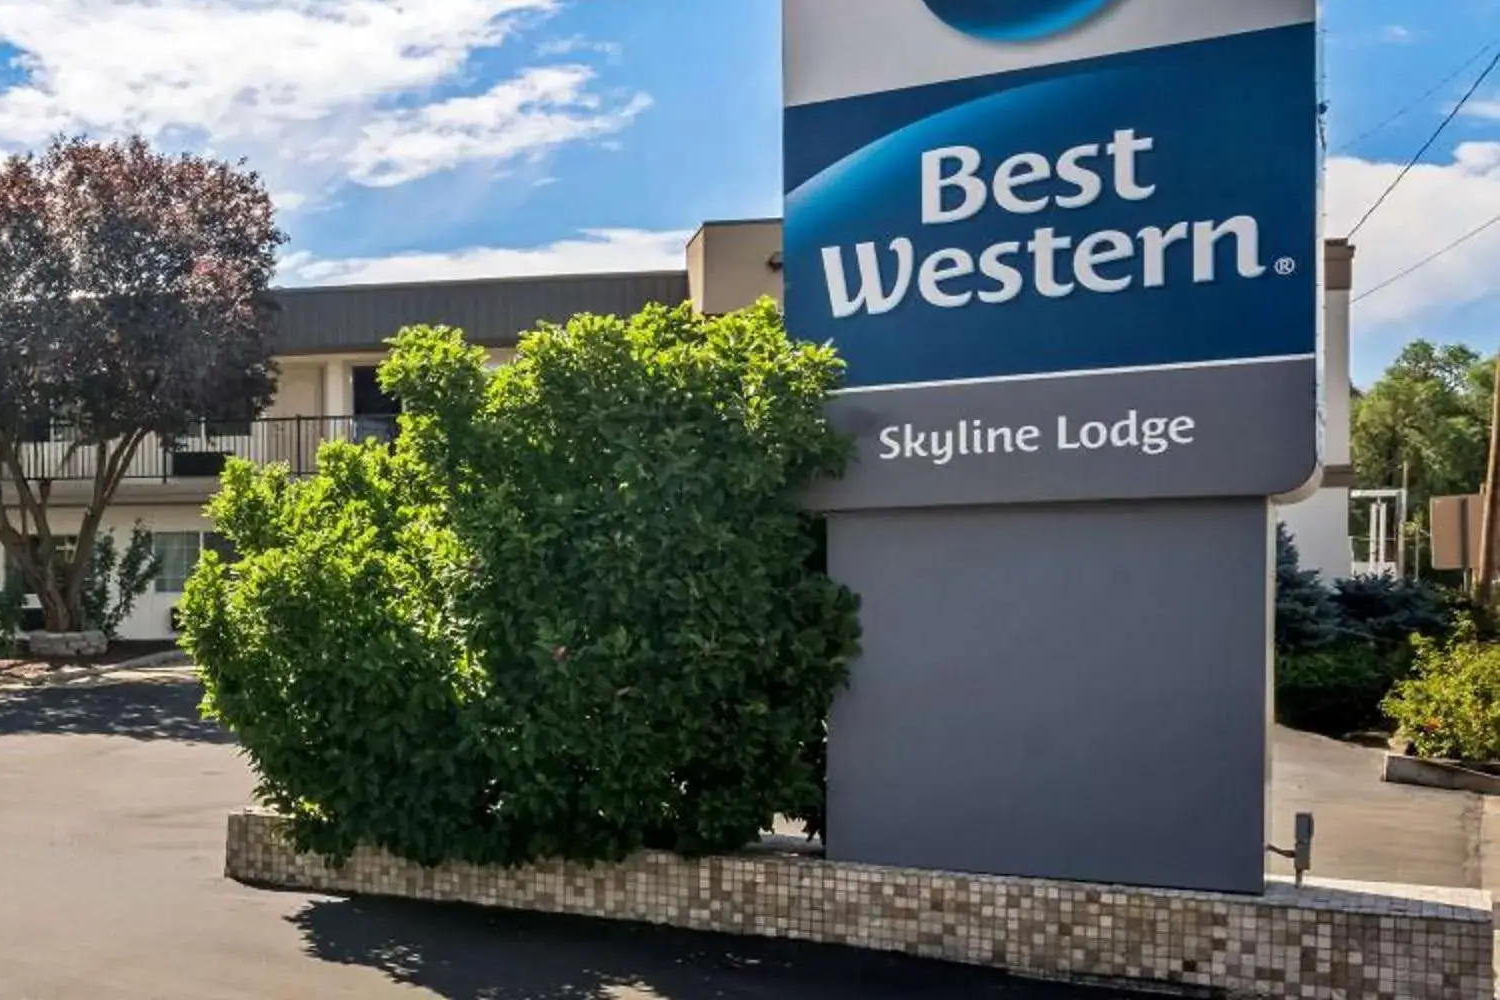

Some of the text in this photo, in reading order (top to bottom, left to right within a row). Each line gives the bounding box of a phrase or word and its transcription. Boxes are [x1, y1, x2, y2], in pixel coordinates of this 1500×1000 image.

[921, 129, 1156, 224] Best
[820, 215, 1266, 318] Western
[879, 410, 1195, 464] Skyline Lodge
